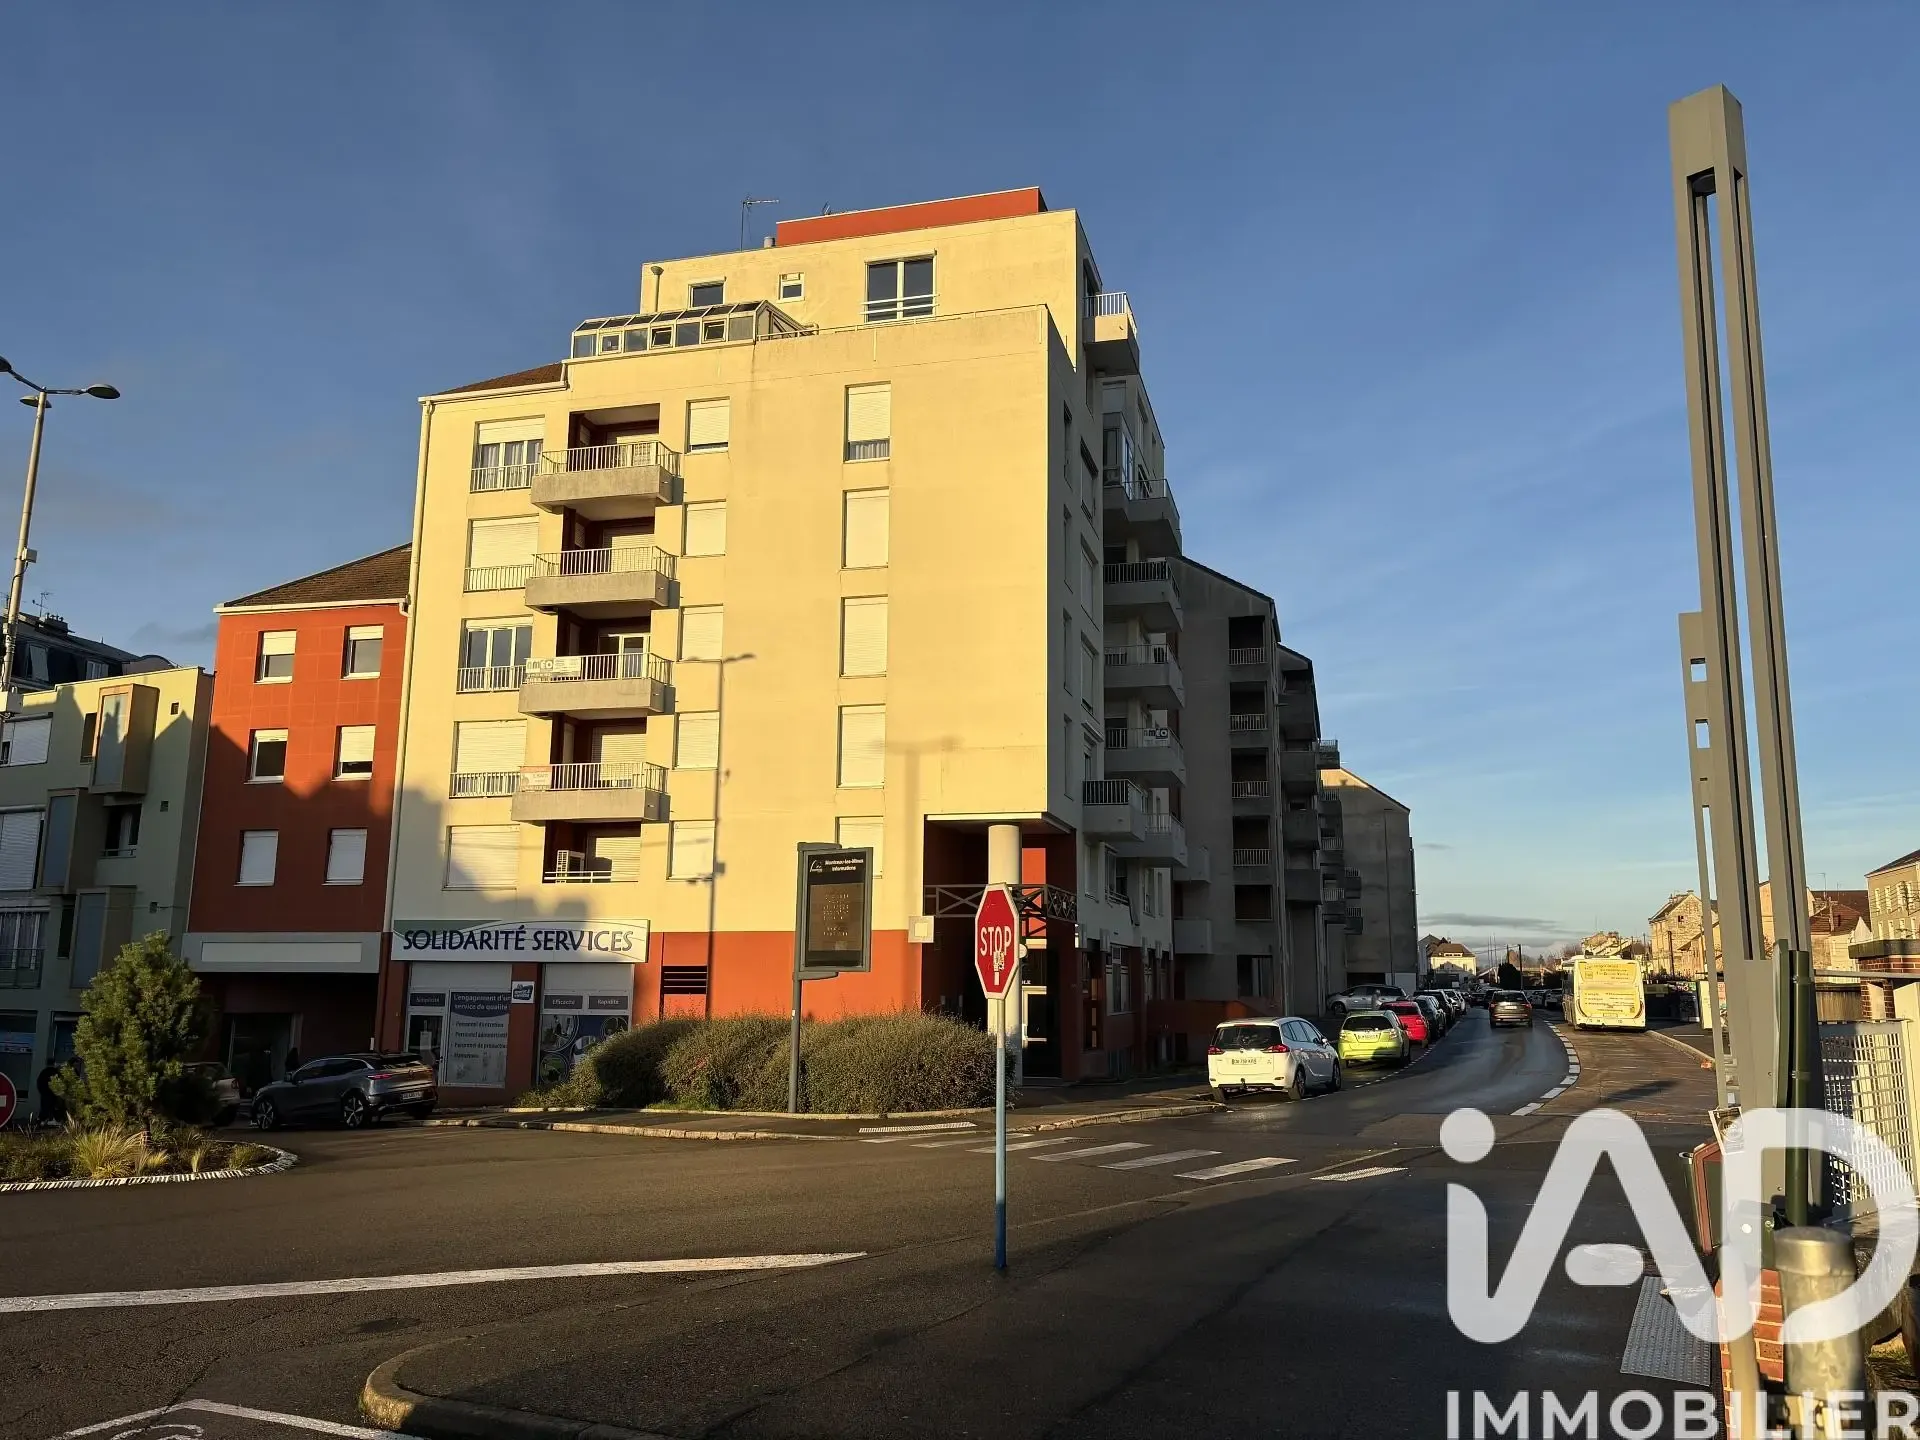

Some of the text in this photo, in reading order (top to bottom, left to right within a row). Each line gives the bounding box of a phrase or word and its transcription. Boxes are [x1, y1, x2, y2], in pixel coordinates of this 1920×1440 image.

[403, 925, 633, 952] SOLIDARITÉ SERVICES
[980, 926, 1012, 956] STOP
[454, 994, 496, 1003] L'engagement
